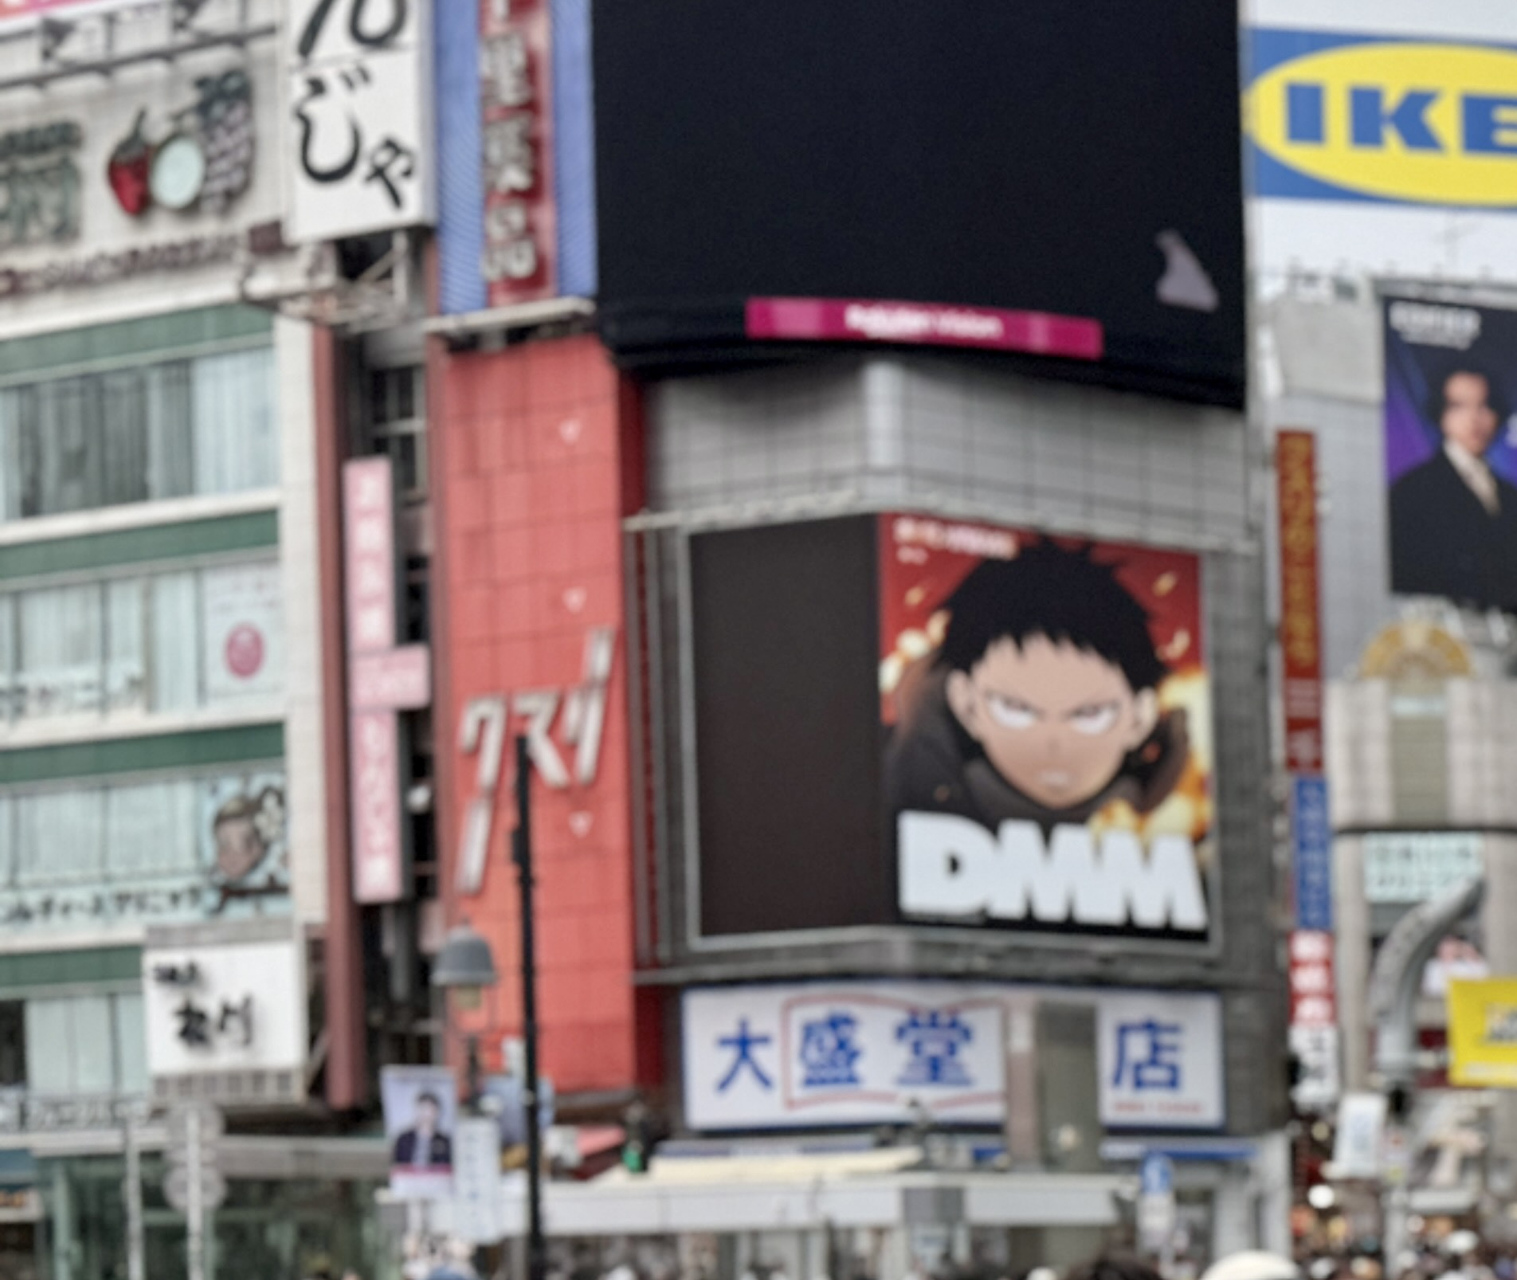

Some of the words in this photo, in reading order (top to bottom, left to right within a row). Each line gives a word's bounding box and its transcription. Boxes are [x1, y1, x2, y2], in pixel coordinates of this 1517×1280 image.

[898, 808, 1209, 930] DMM
[715, 1009, 1185, 1092] 大盛堂店
